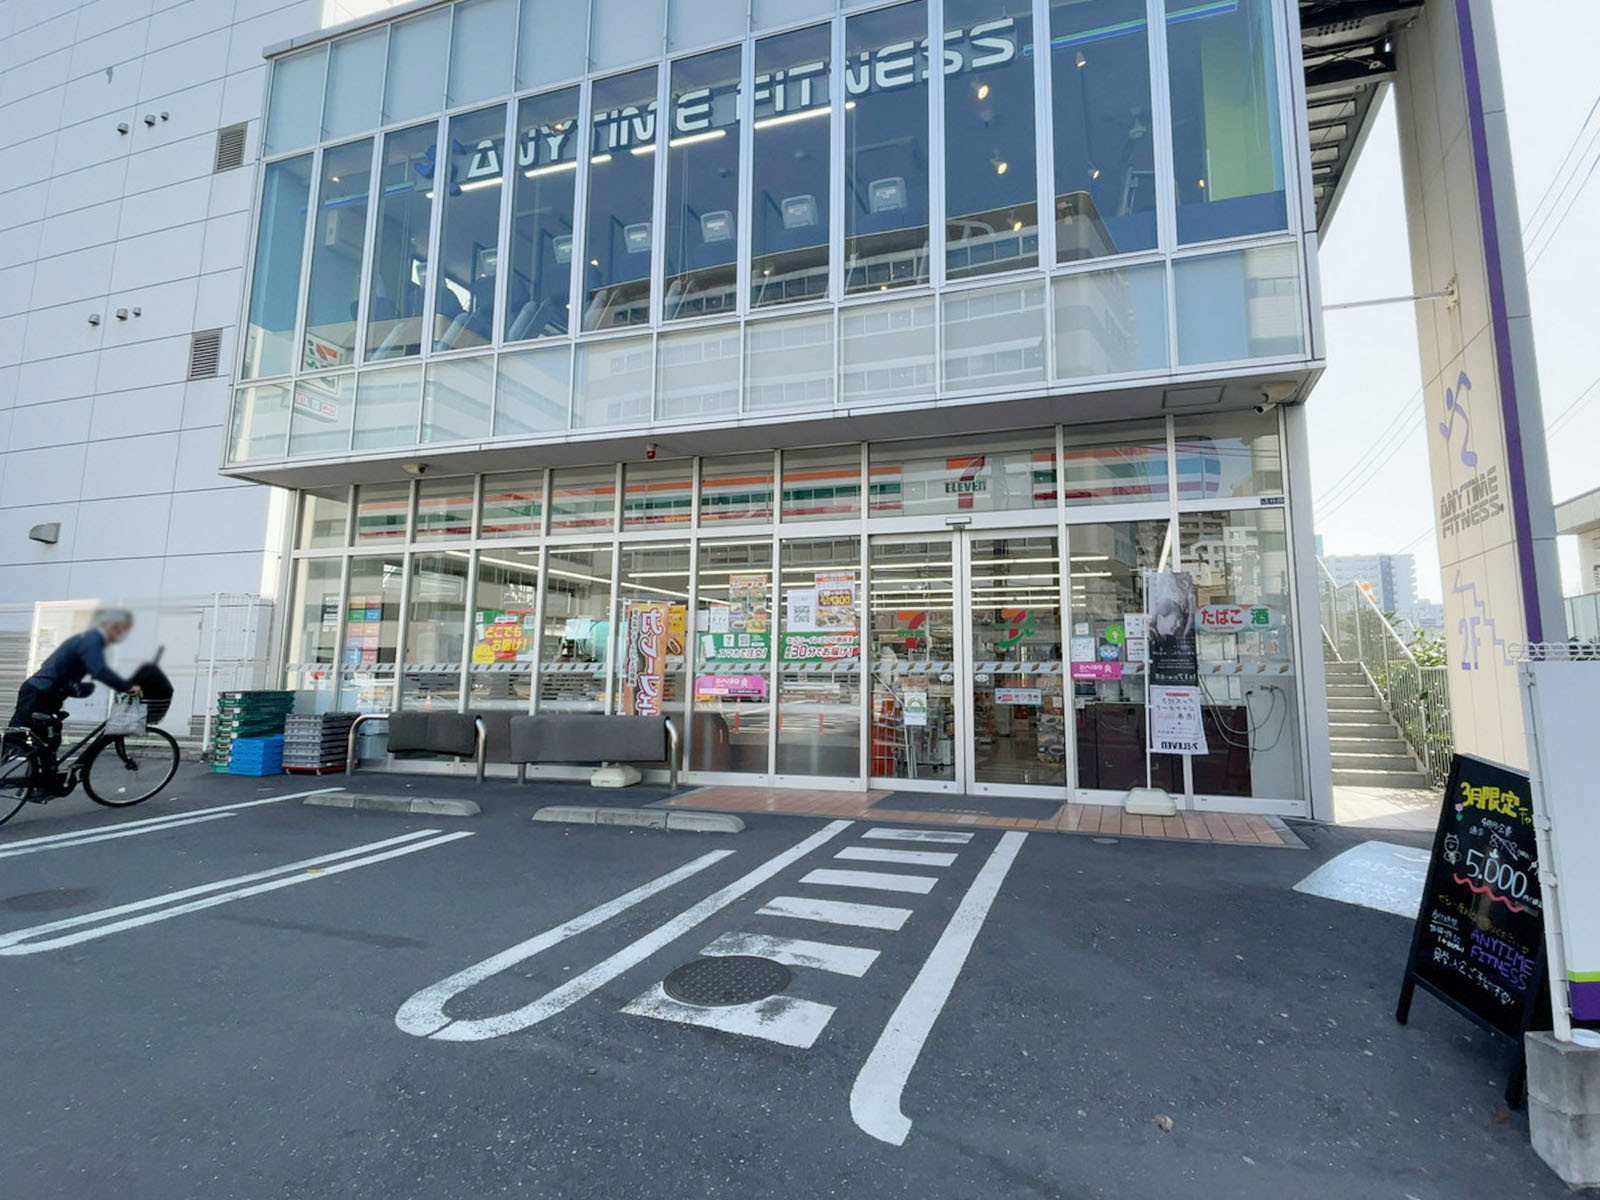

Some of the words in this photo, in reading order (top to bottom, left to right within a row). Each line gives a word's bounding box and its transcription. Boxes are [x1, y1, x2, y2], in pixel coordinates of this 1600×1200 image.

[736, 17, 1016, 120] FITNESS
[1440, 465, 1498, 520] ANYTIME
[1442, 493, 1500, 540] FITNESS
[485, 624, 523, 640] どこでも
[1201, 608, 1243, 625] たばこ
[1251, 607, 1269, 625] 酒
[1458, 616, 1480, 670] 2F
[1460, 782, 1520, 818] 3月限定
[1470, 944, 1527, 990] FITNESS
[1471, 928, 1535, 976] ANYTIME
